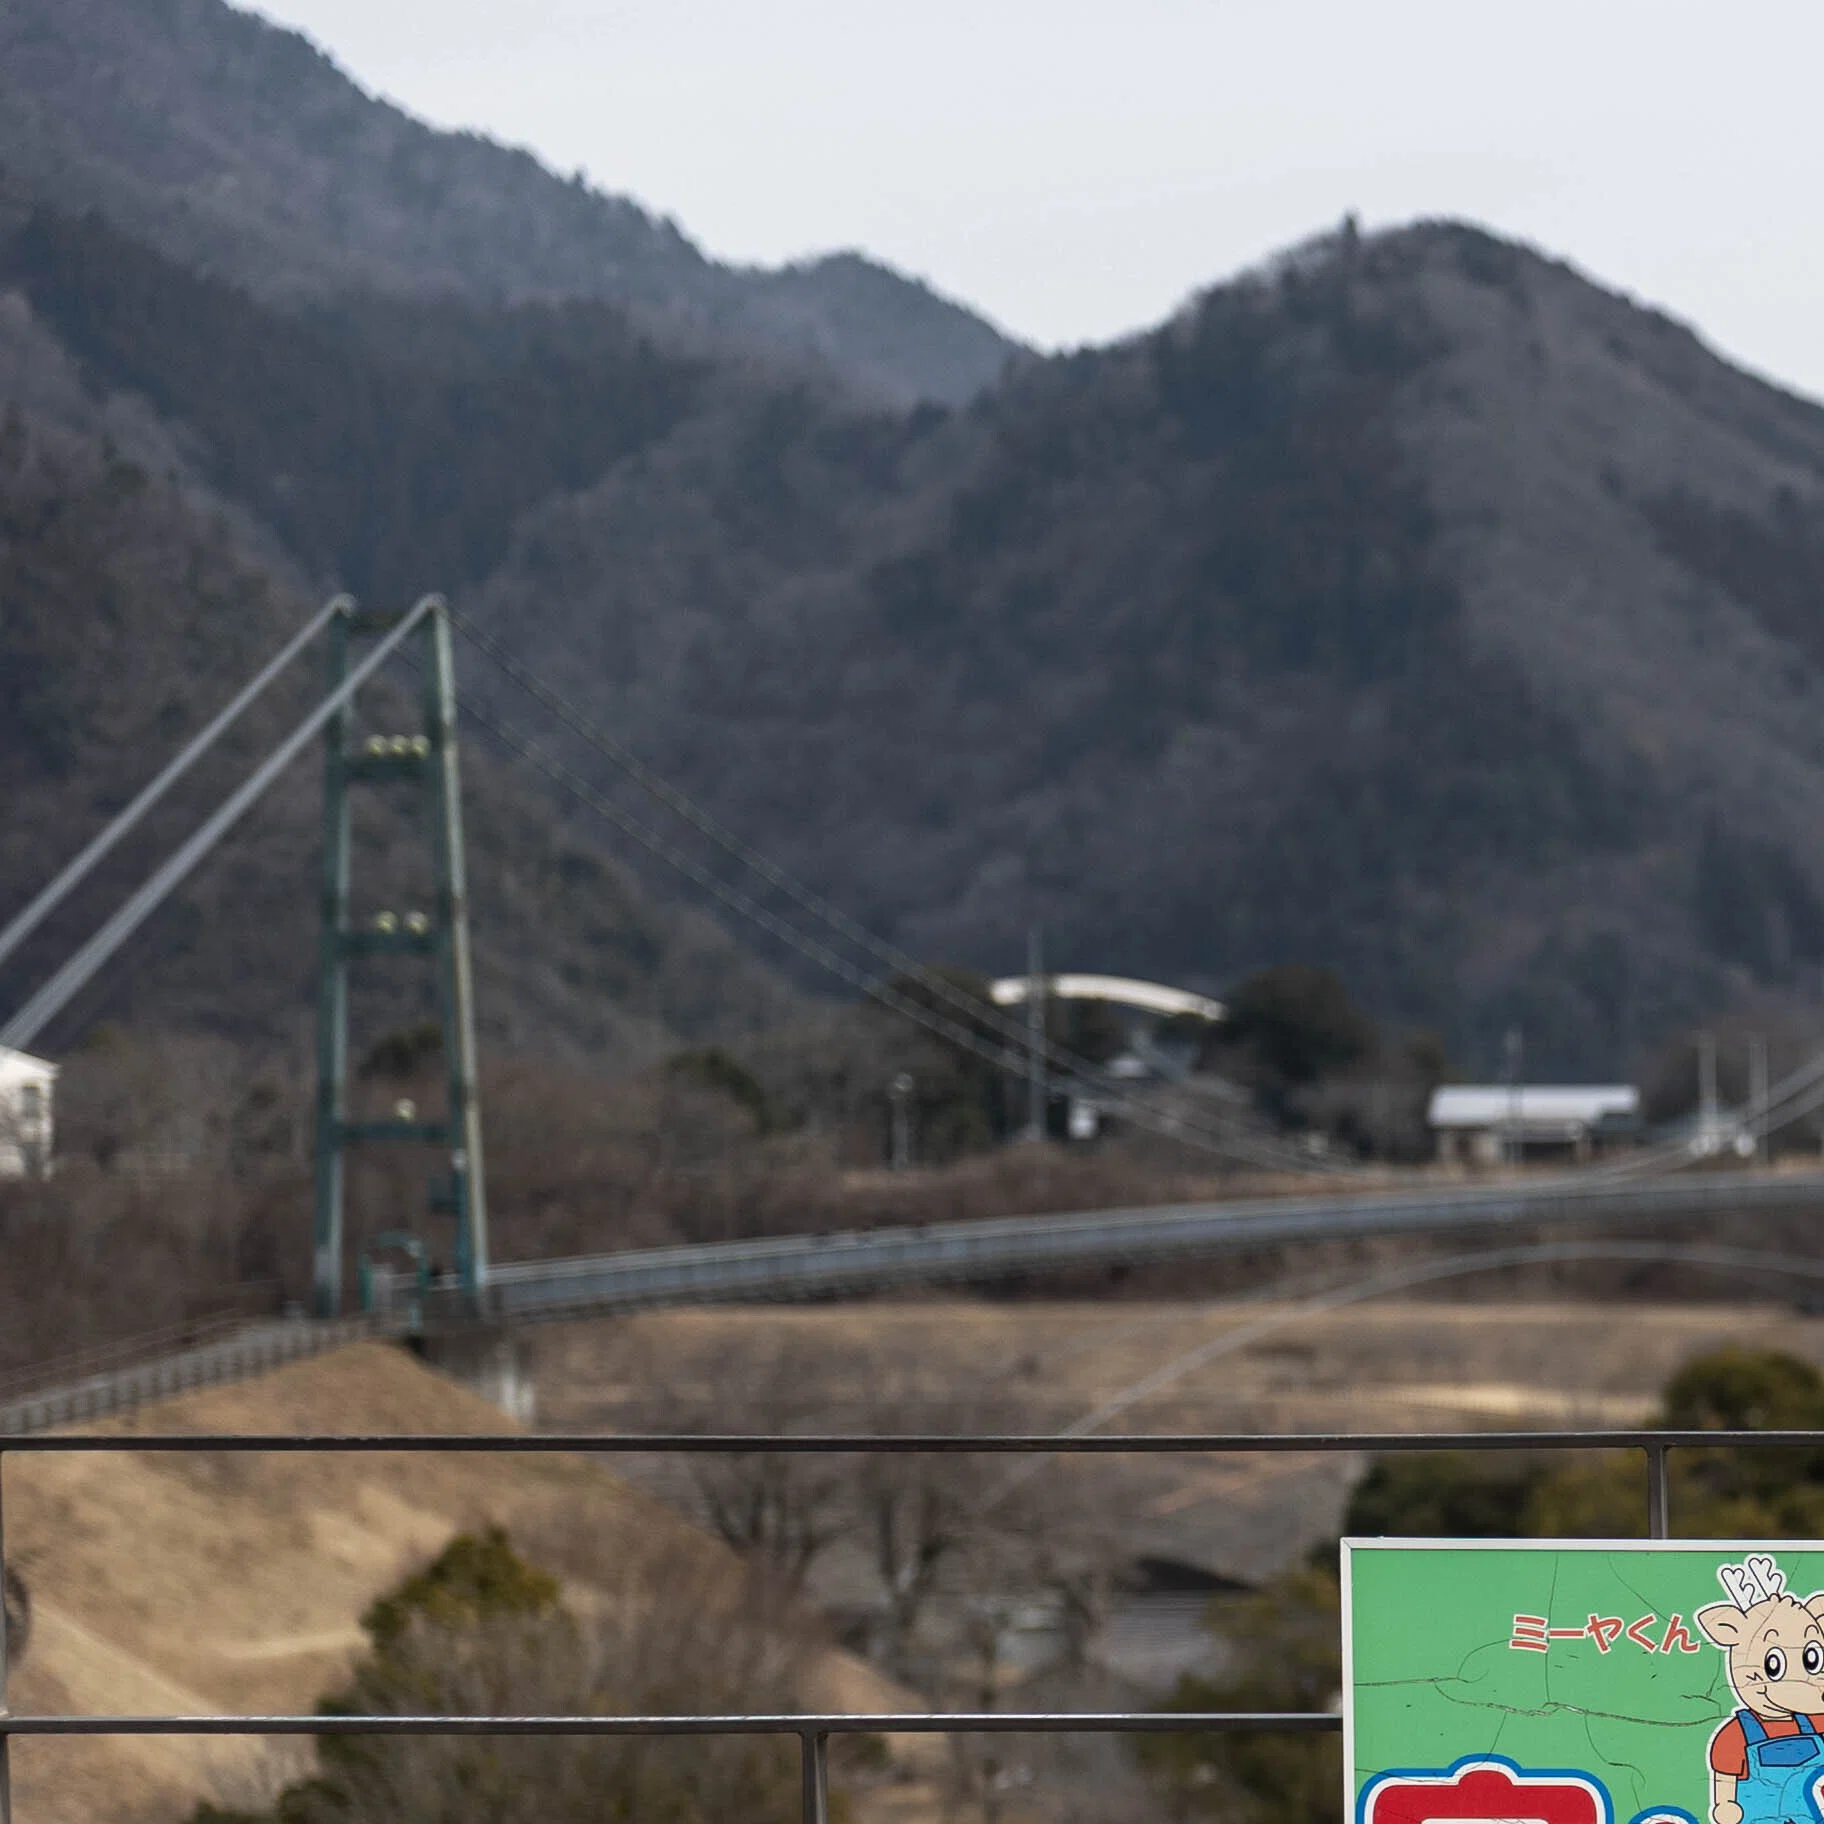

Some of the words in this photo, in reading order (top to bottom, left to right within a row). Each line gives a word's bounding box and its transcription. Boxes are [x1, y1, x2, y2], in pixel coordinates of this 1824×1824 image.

[1509, 1612, 1700, 1655] ミーヤくん
